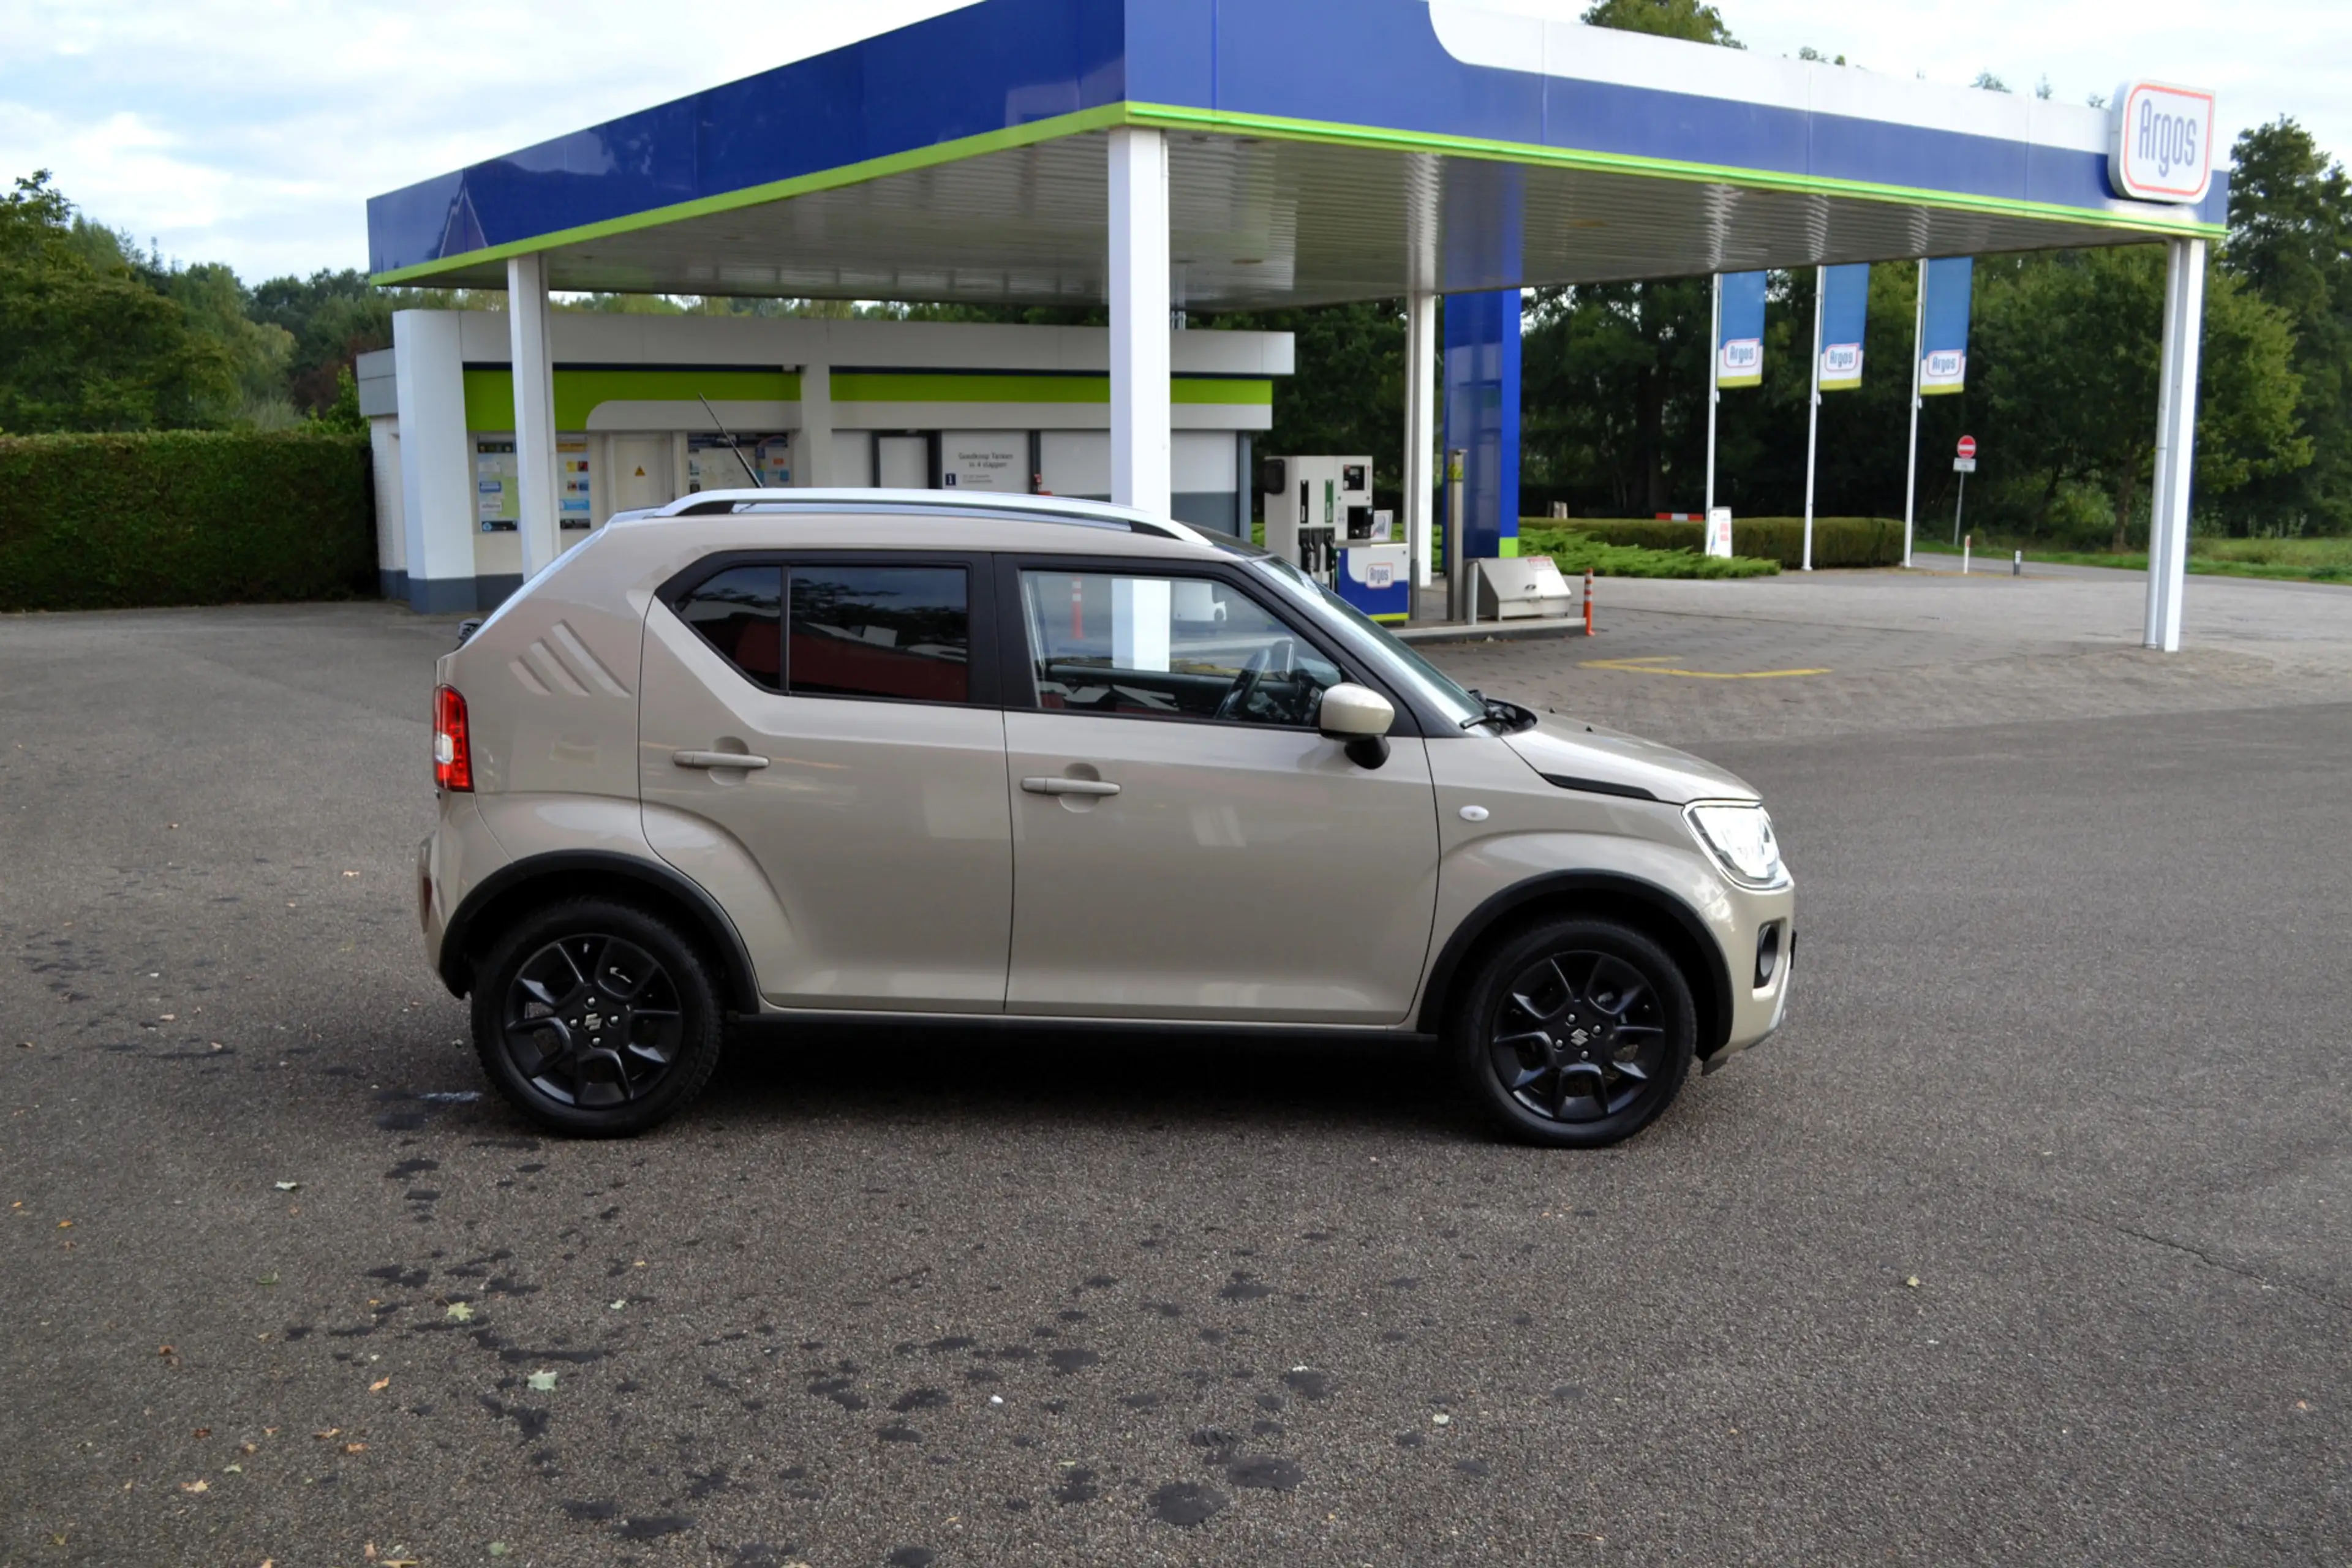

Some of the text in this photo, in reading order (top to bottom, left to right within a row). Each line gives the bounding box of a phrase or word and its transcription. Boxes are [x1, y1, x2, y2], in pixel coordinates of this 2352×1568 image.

[2138, 98, 2197, 177] Argos
[1730, 345, 1754, 364] Argos
[1829, 349, 1853, 368] Argos
[1932, 355, 1956, 373] Argos
[1370, 567, 1389, 584] Argos
